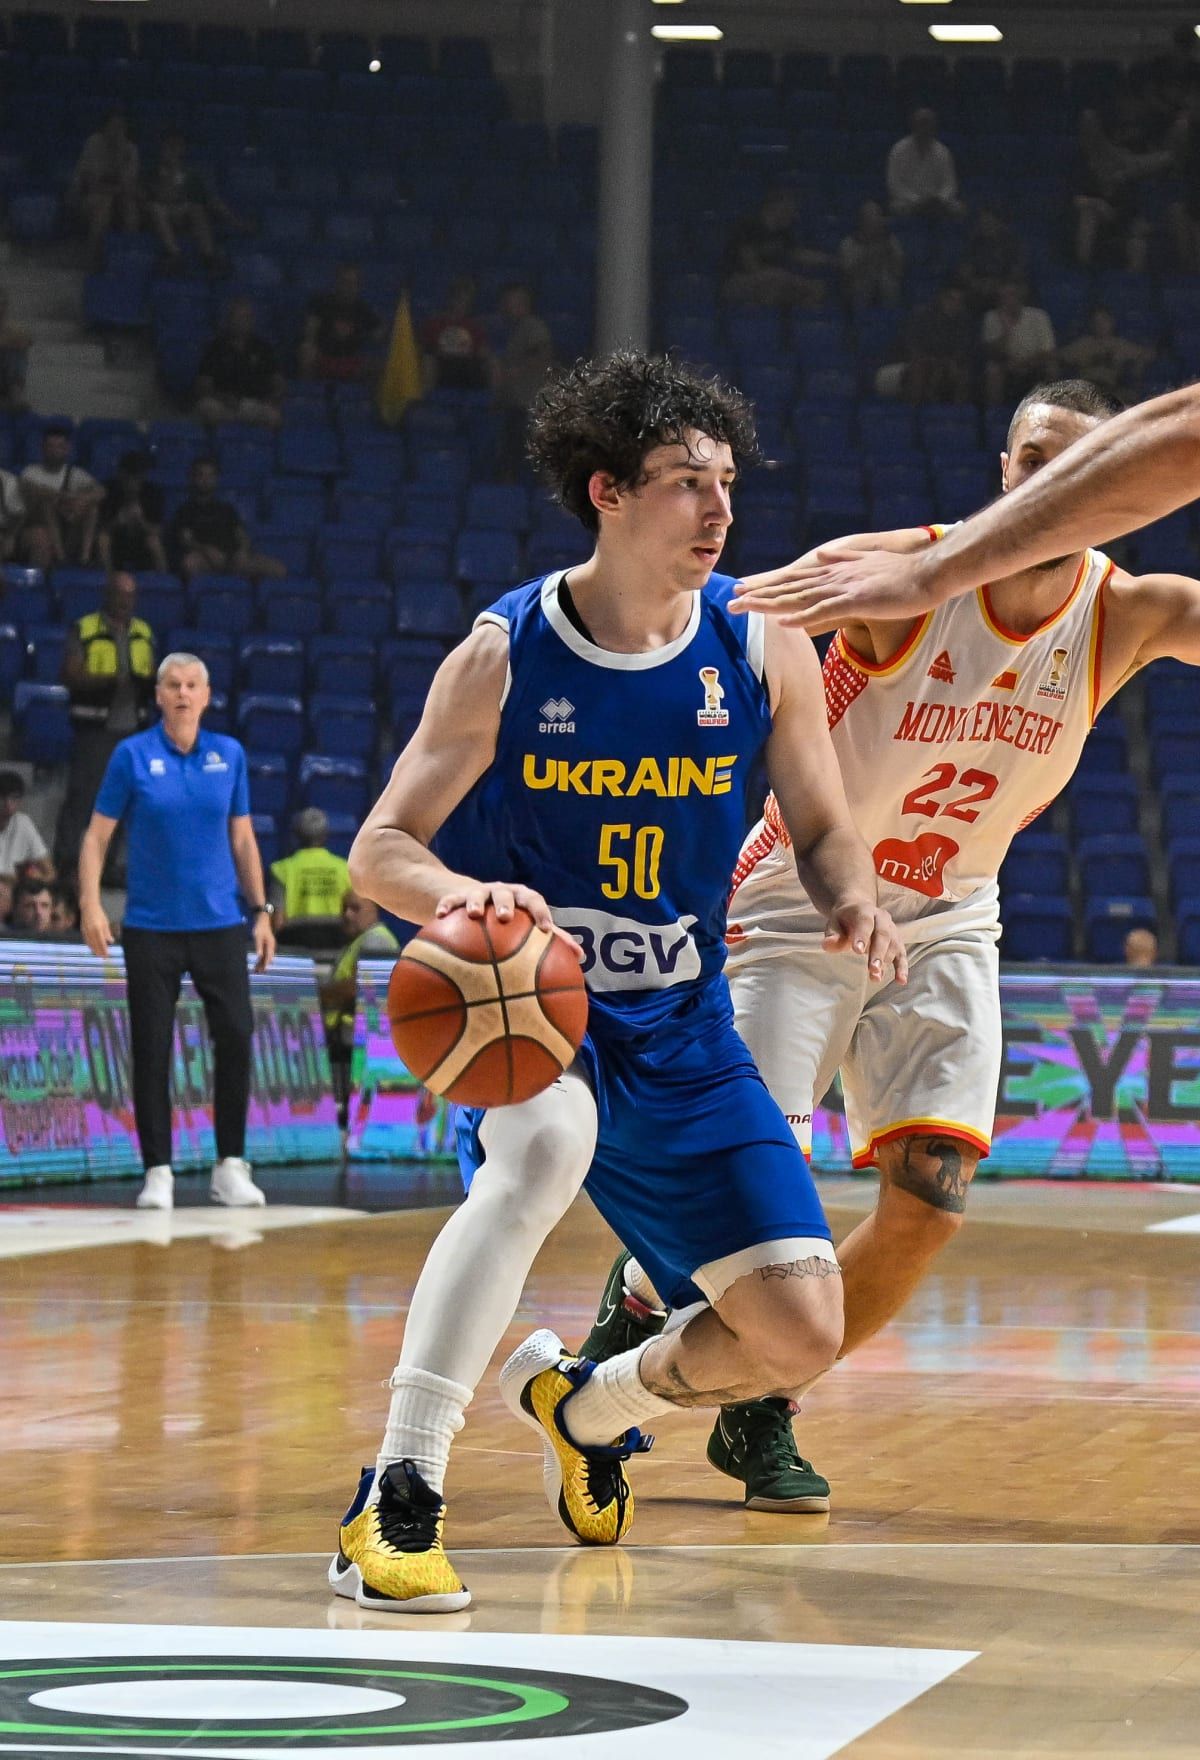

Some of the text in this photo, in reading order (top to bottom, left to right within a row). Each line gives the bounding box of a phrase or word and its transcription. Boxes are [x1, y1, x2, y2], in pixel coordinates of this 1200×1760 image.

[522, 754, 738, 798] UKRAINE
[901, 762, 999, 824] 22
[598, 823, 665, 900] 50
[558, 925, 689, 974] BGV
